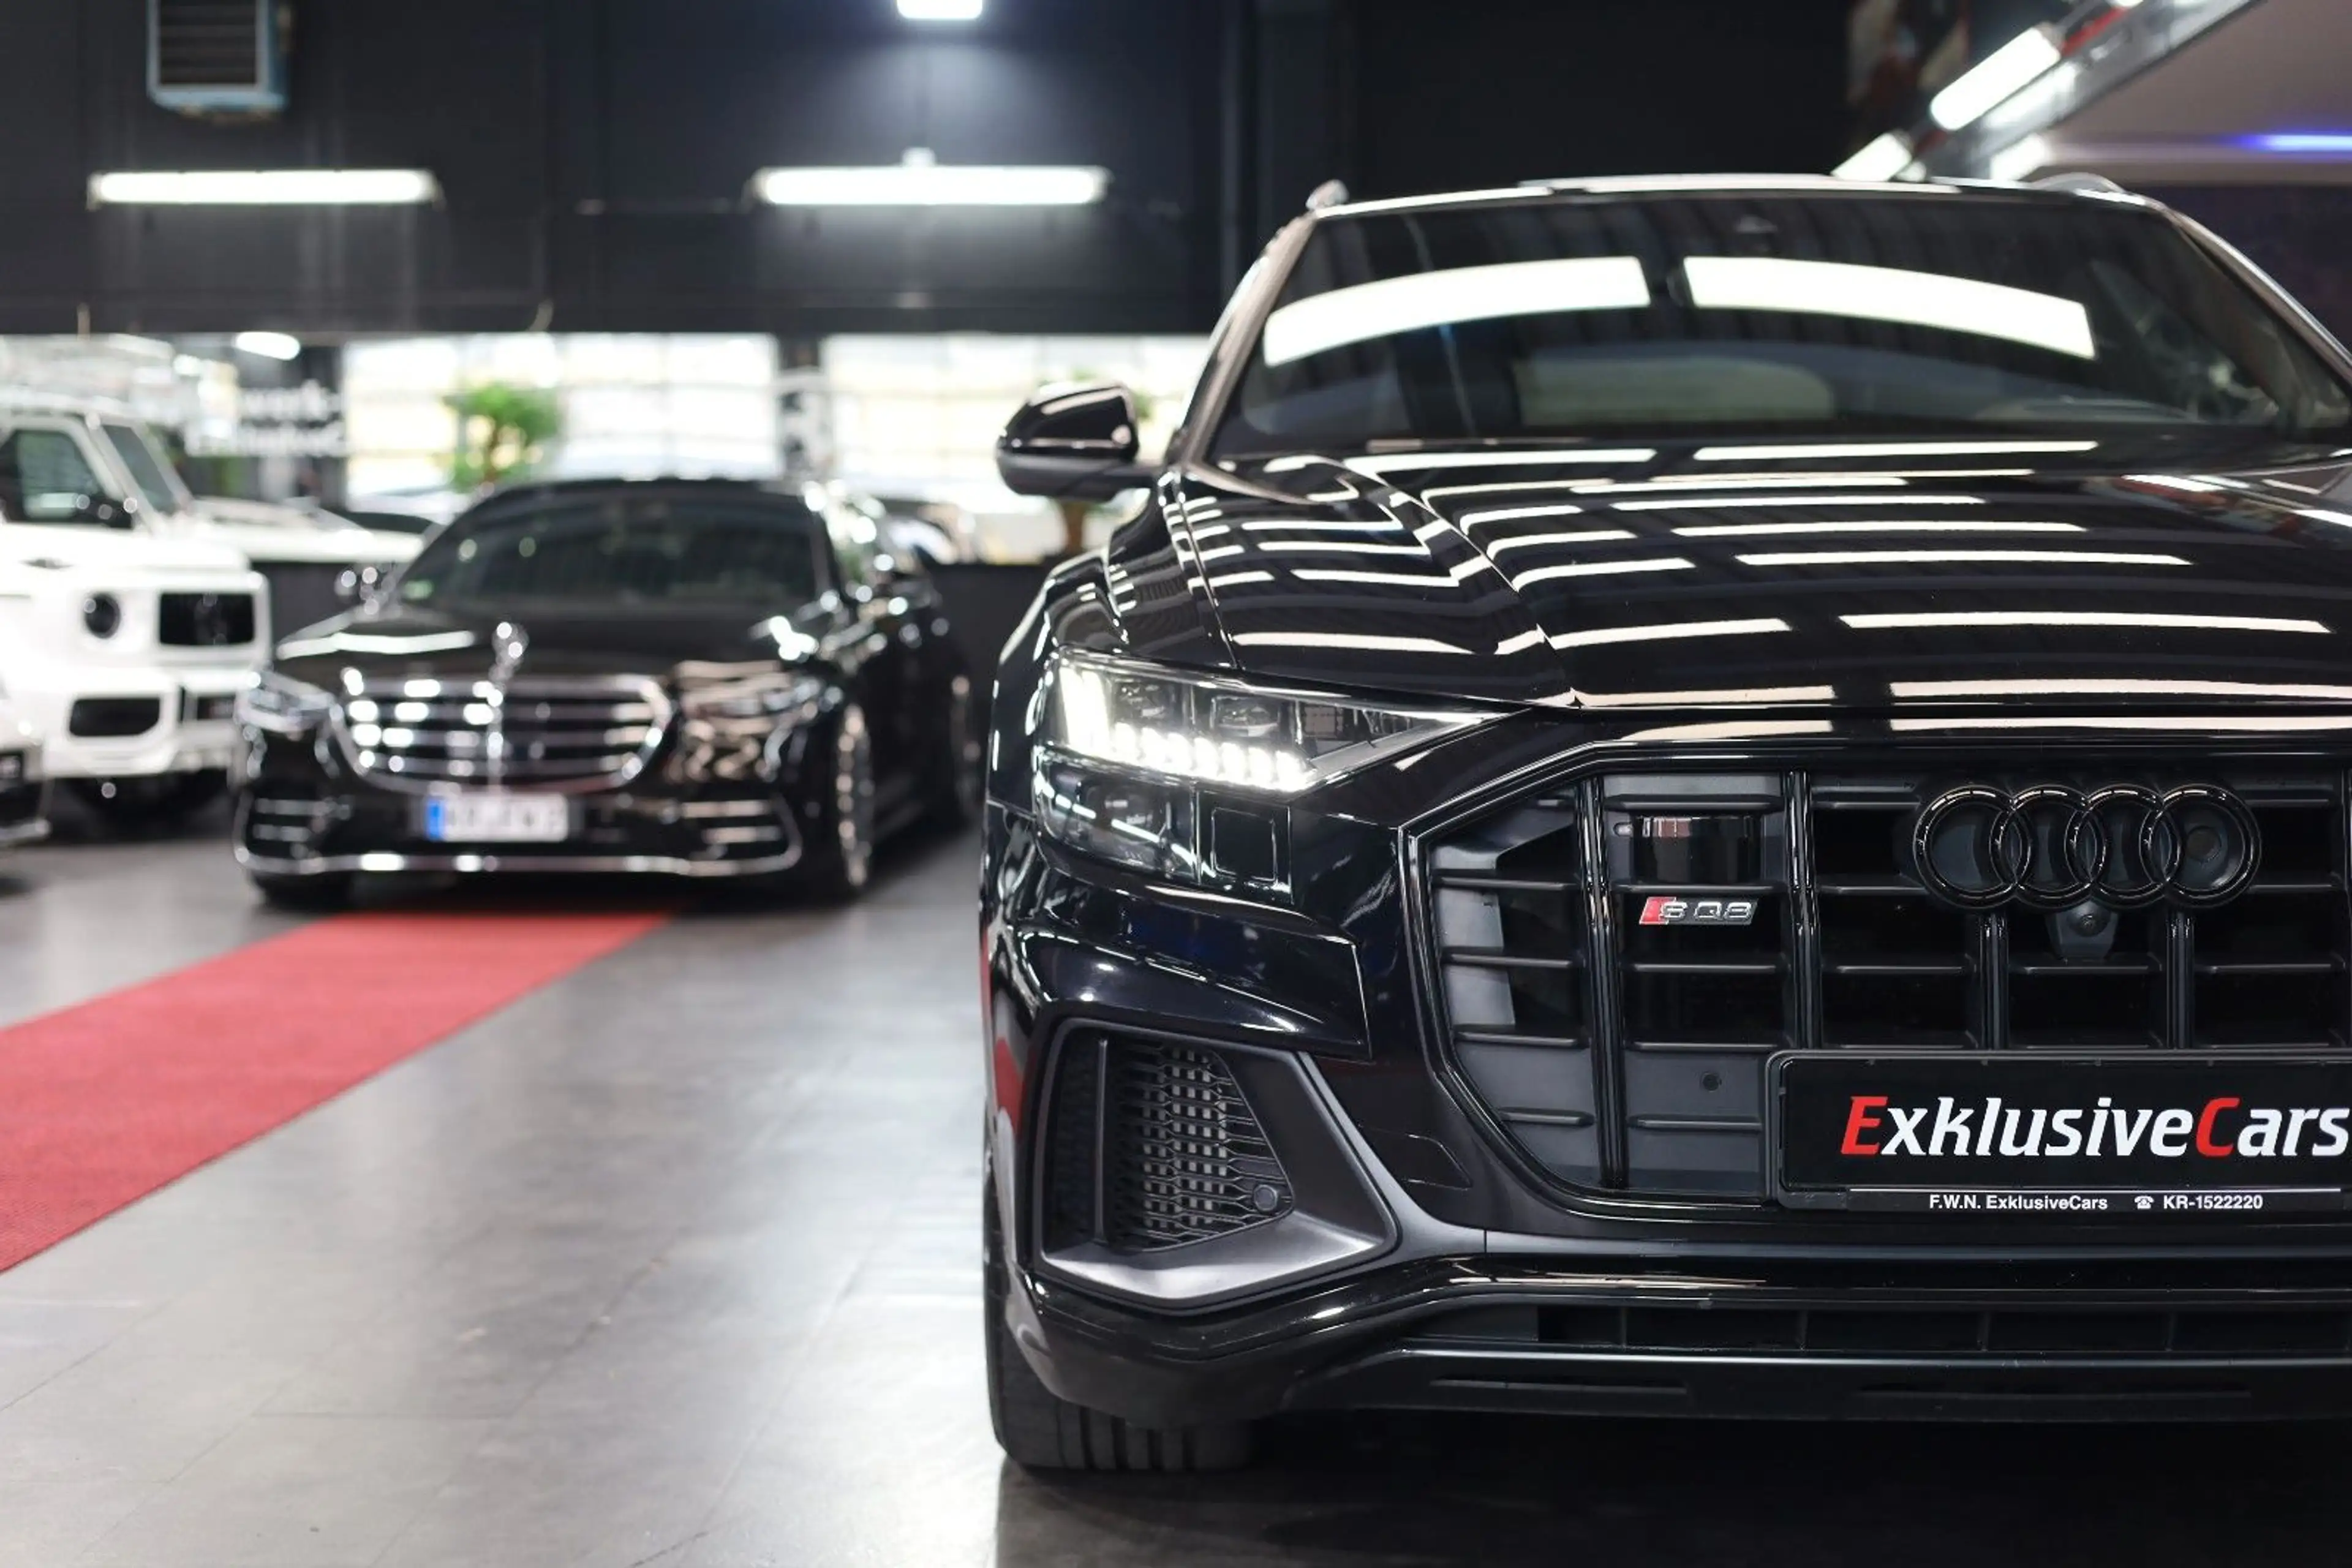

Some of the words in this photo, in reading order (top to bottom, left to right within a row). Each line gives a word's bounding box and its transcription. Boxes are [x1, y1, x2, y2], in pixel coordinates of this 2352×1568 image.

[1841, 1096, 2350, 1158] ExklusiveCars
[1929, 1194, 1981, 1210] F.W.N.
[1986, 1194, 2108, 1210] ExklusiveCars
[2163, 1194, 2263, 1210] KR-1522220
